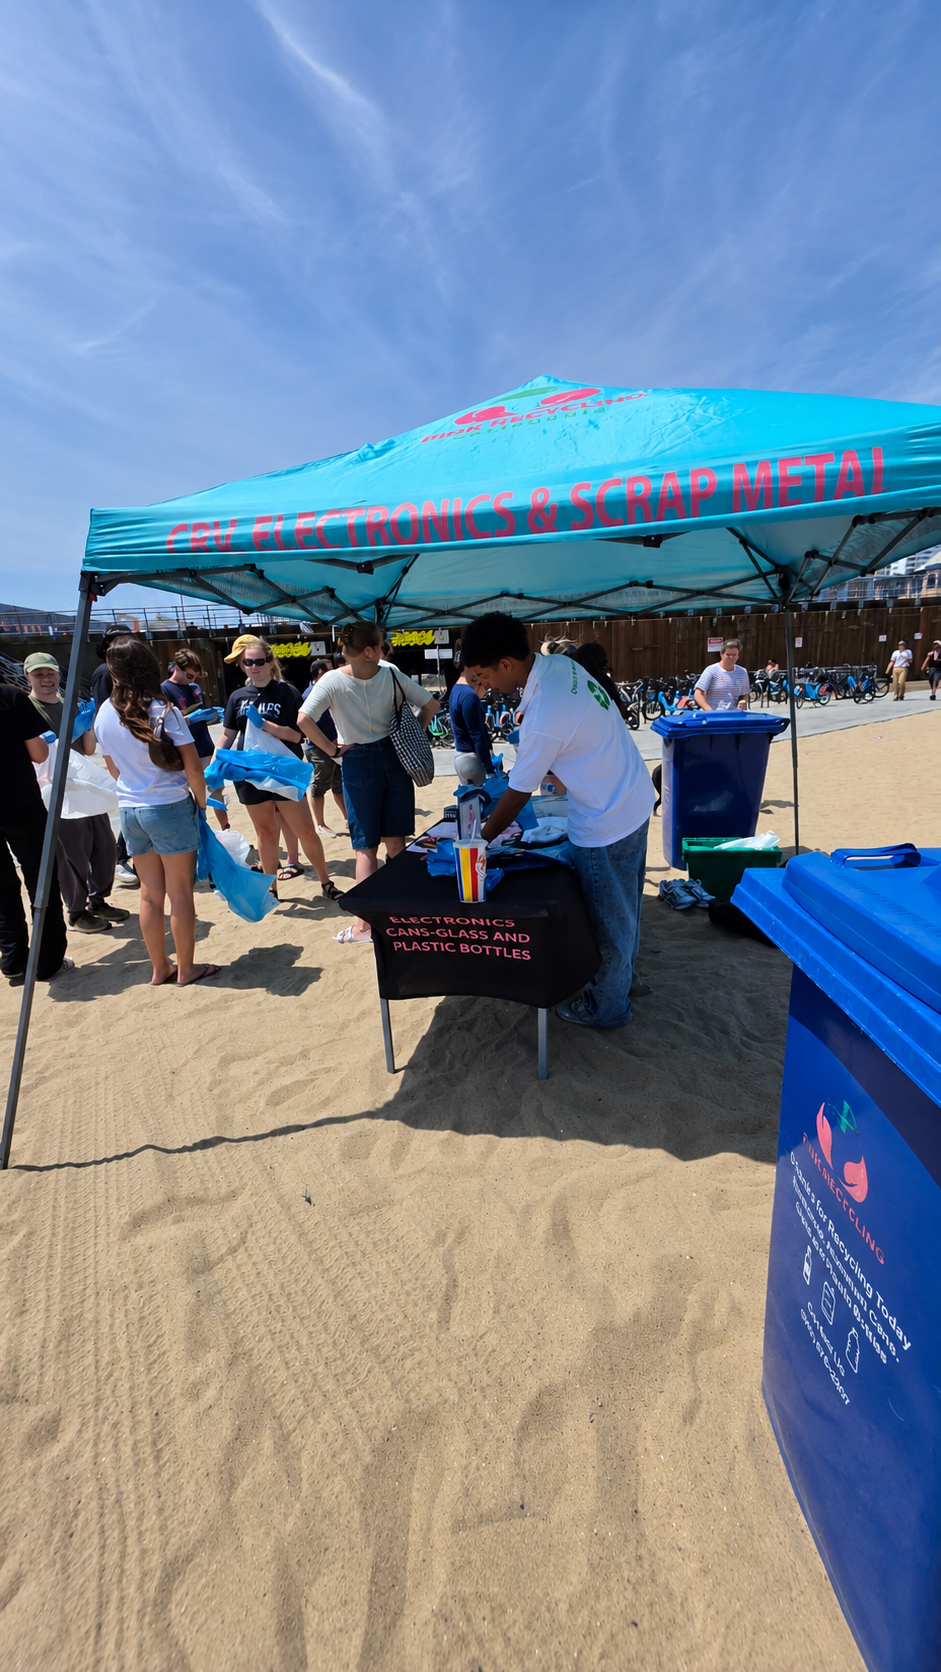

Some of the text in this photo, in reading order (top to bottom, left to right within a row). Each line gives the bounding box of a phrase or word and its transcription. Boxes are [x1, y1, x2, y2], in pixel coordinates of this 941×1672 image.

[166, 446, 889, 554] CRV ELECTRONICS & SCRAP METAL
[389, 916, 516, 928] ELECTRONICS
[385, 927, 531, 944] CANS-GLASS AND
[393, 941, 532, 961] PLASTIC BOTTLES
[816, 1200, 828, 1223] for
[828, 1219, 873, 1299] Recycling
[876, 1291, 912, 1351] Today
